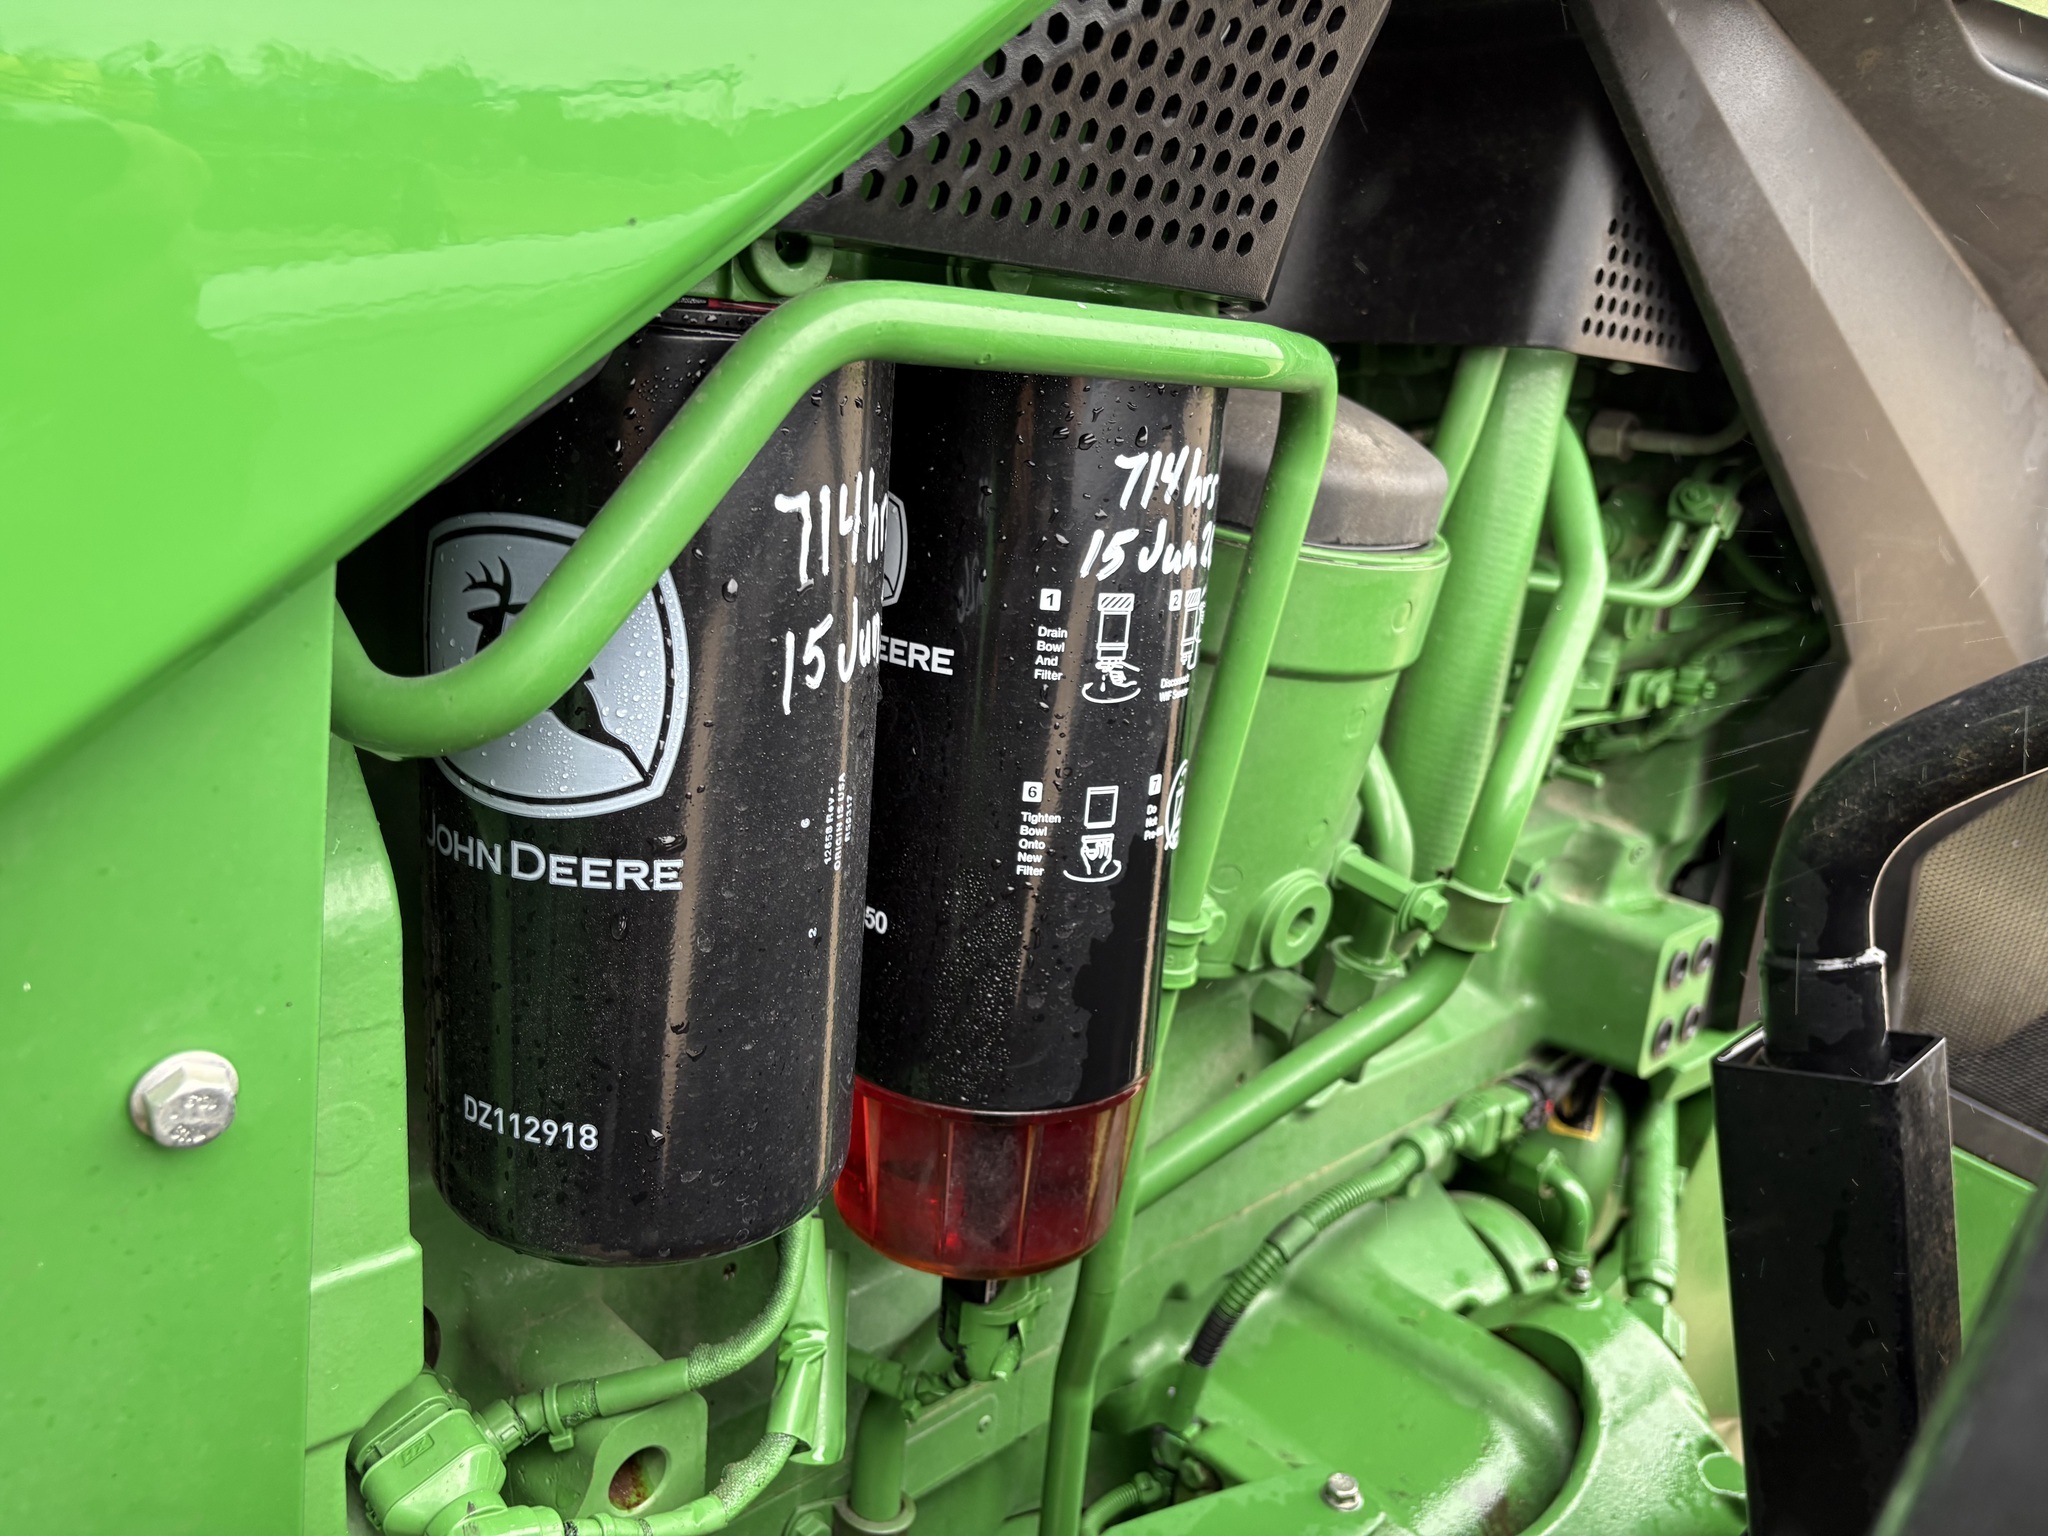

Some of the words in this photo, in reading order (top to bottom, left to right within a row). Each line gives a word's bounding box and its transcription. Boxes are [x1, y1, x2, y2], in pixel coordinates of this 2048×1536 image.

[1080, 528, 1140, 582] 15
[1137, 518, 1198, 576] Jun
[1037, 625, 1069, 640] Drain
[1036, 640, 1066, 654] Bowl
[782, 613, 834, 715] 15
[837, 596, 881, 684] Jun
[879, 634, 955, 676] EERE
[1034, 654, 1059, 667] And
[1033, 668, 1064, 682] Filter
[837, 771, 846, 803] USA
[1020, 811, 1062, 825] Tighten
[1019, 824, 1048, 838] Bowl
[833, 820, 844, 872] ORIGIN
[1018, 838, 1046, 851] Onto
[427, 813, 502, 876] JOHN
[511, 840, 684, 891] DEERE
[1017, 851, 1043, 864] New
[1016, 864, 1045, 877] Filter
[464, 1093, 599, 1152] DZ112918
